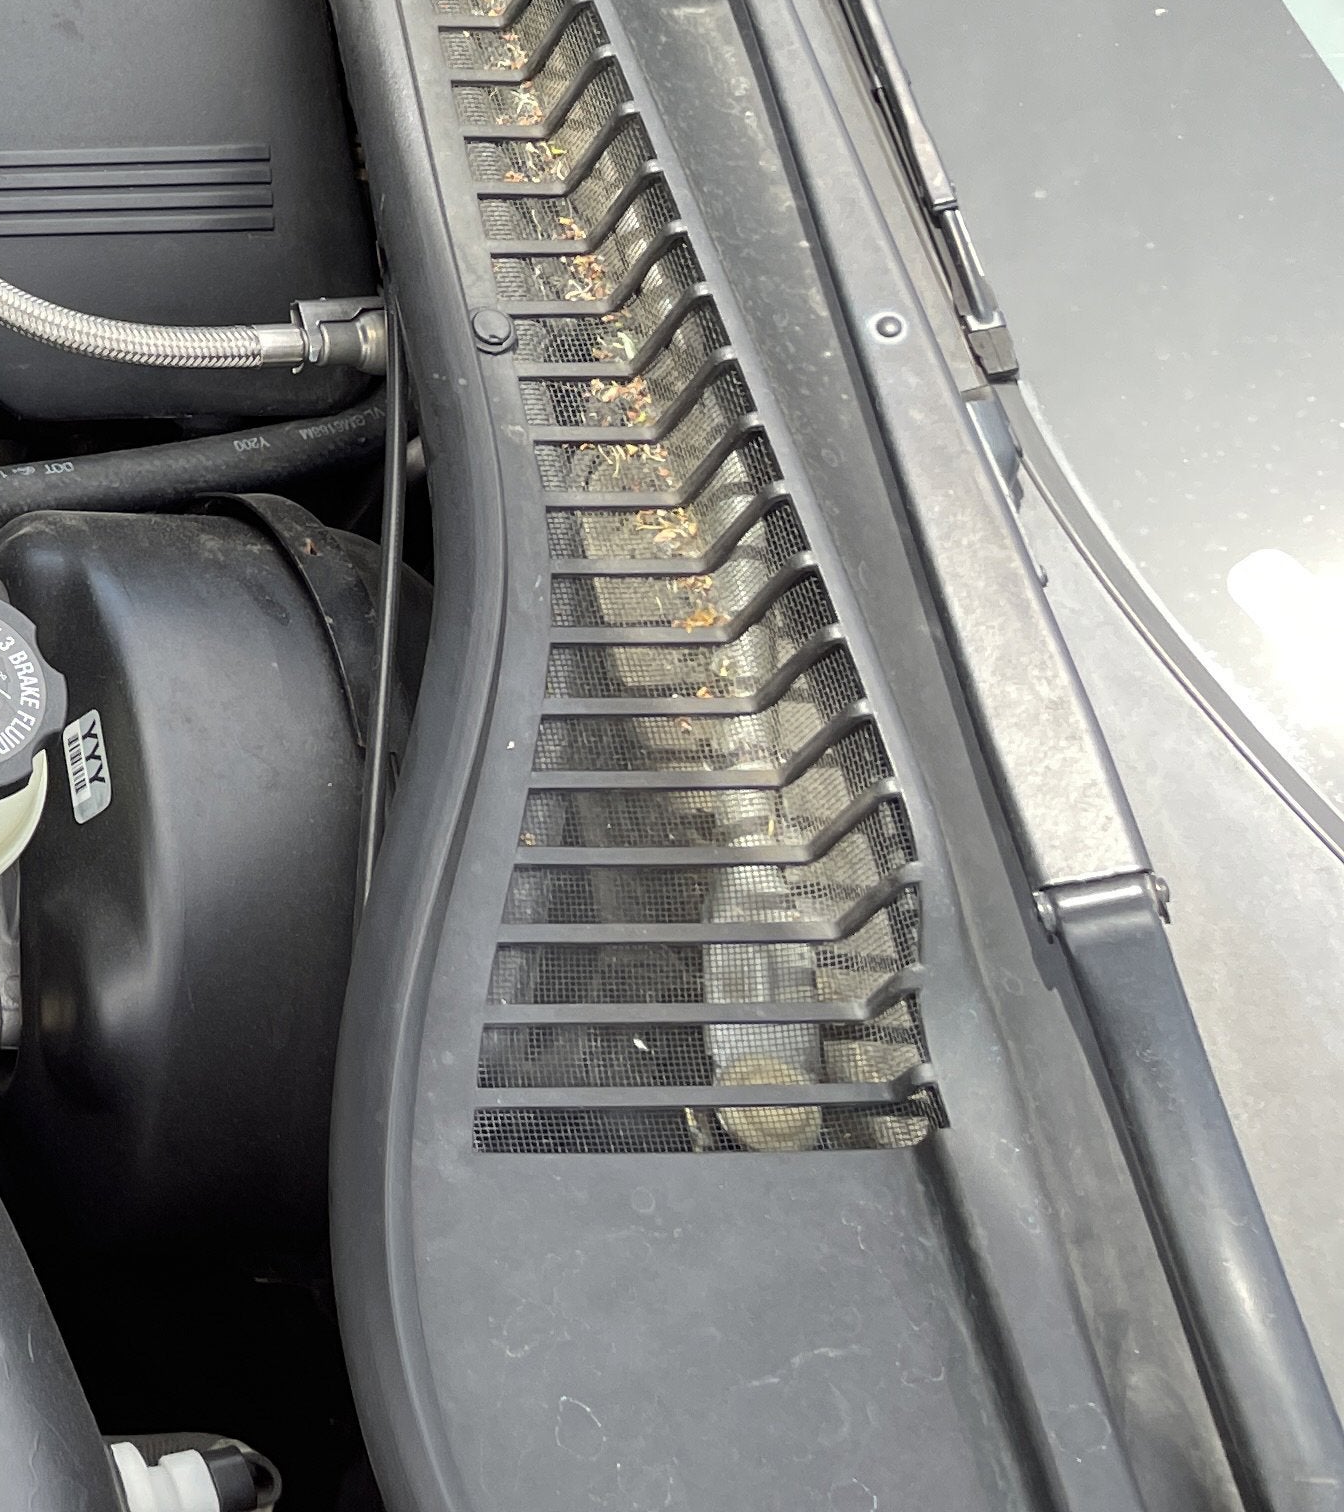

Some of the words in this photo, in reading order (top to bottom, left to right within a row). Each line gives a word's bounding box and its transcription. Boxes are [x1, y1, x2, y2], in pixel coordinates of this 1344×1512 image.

[43, 461, 74, 475] DOT
[8, 650, 41, 710] BRAKE
[81, 718, 106, 784] YYY
